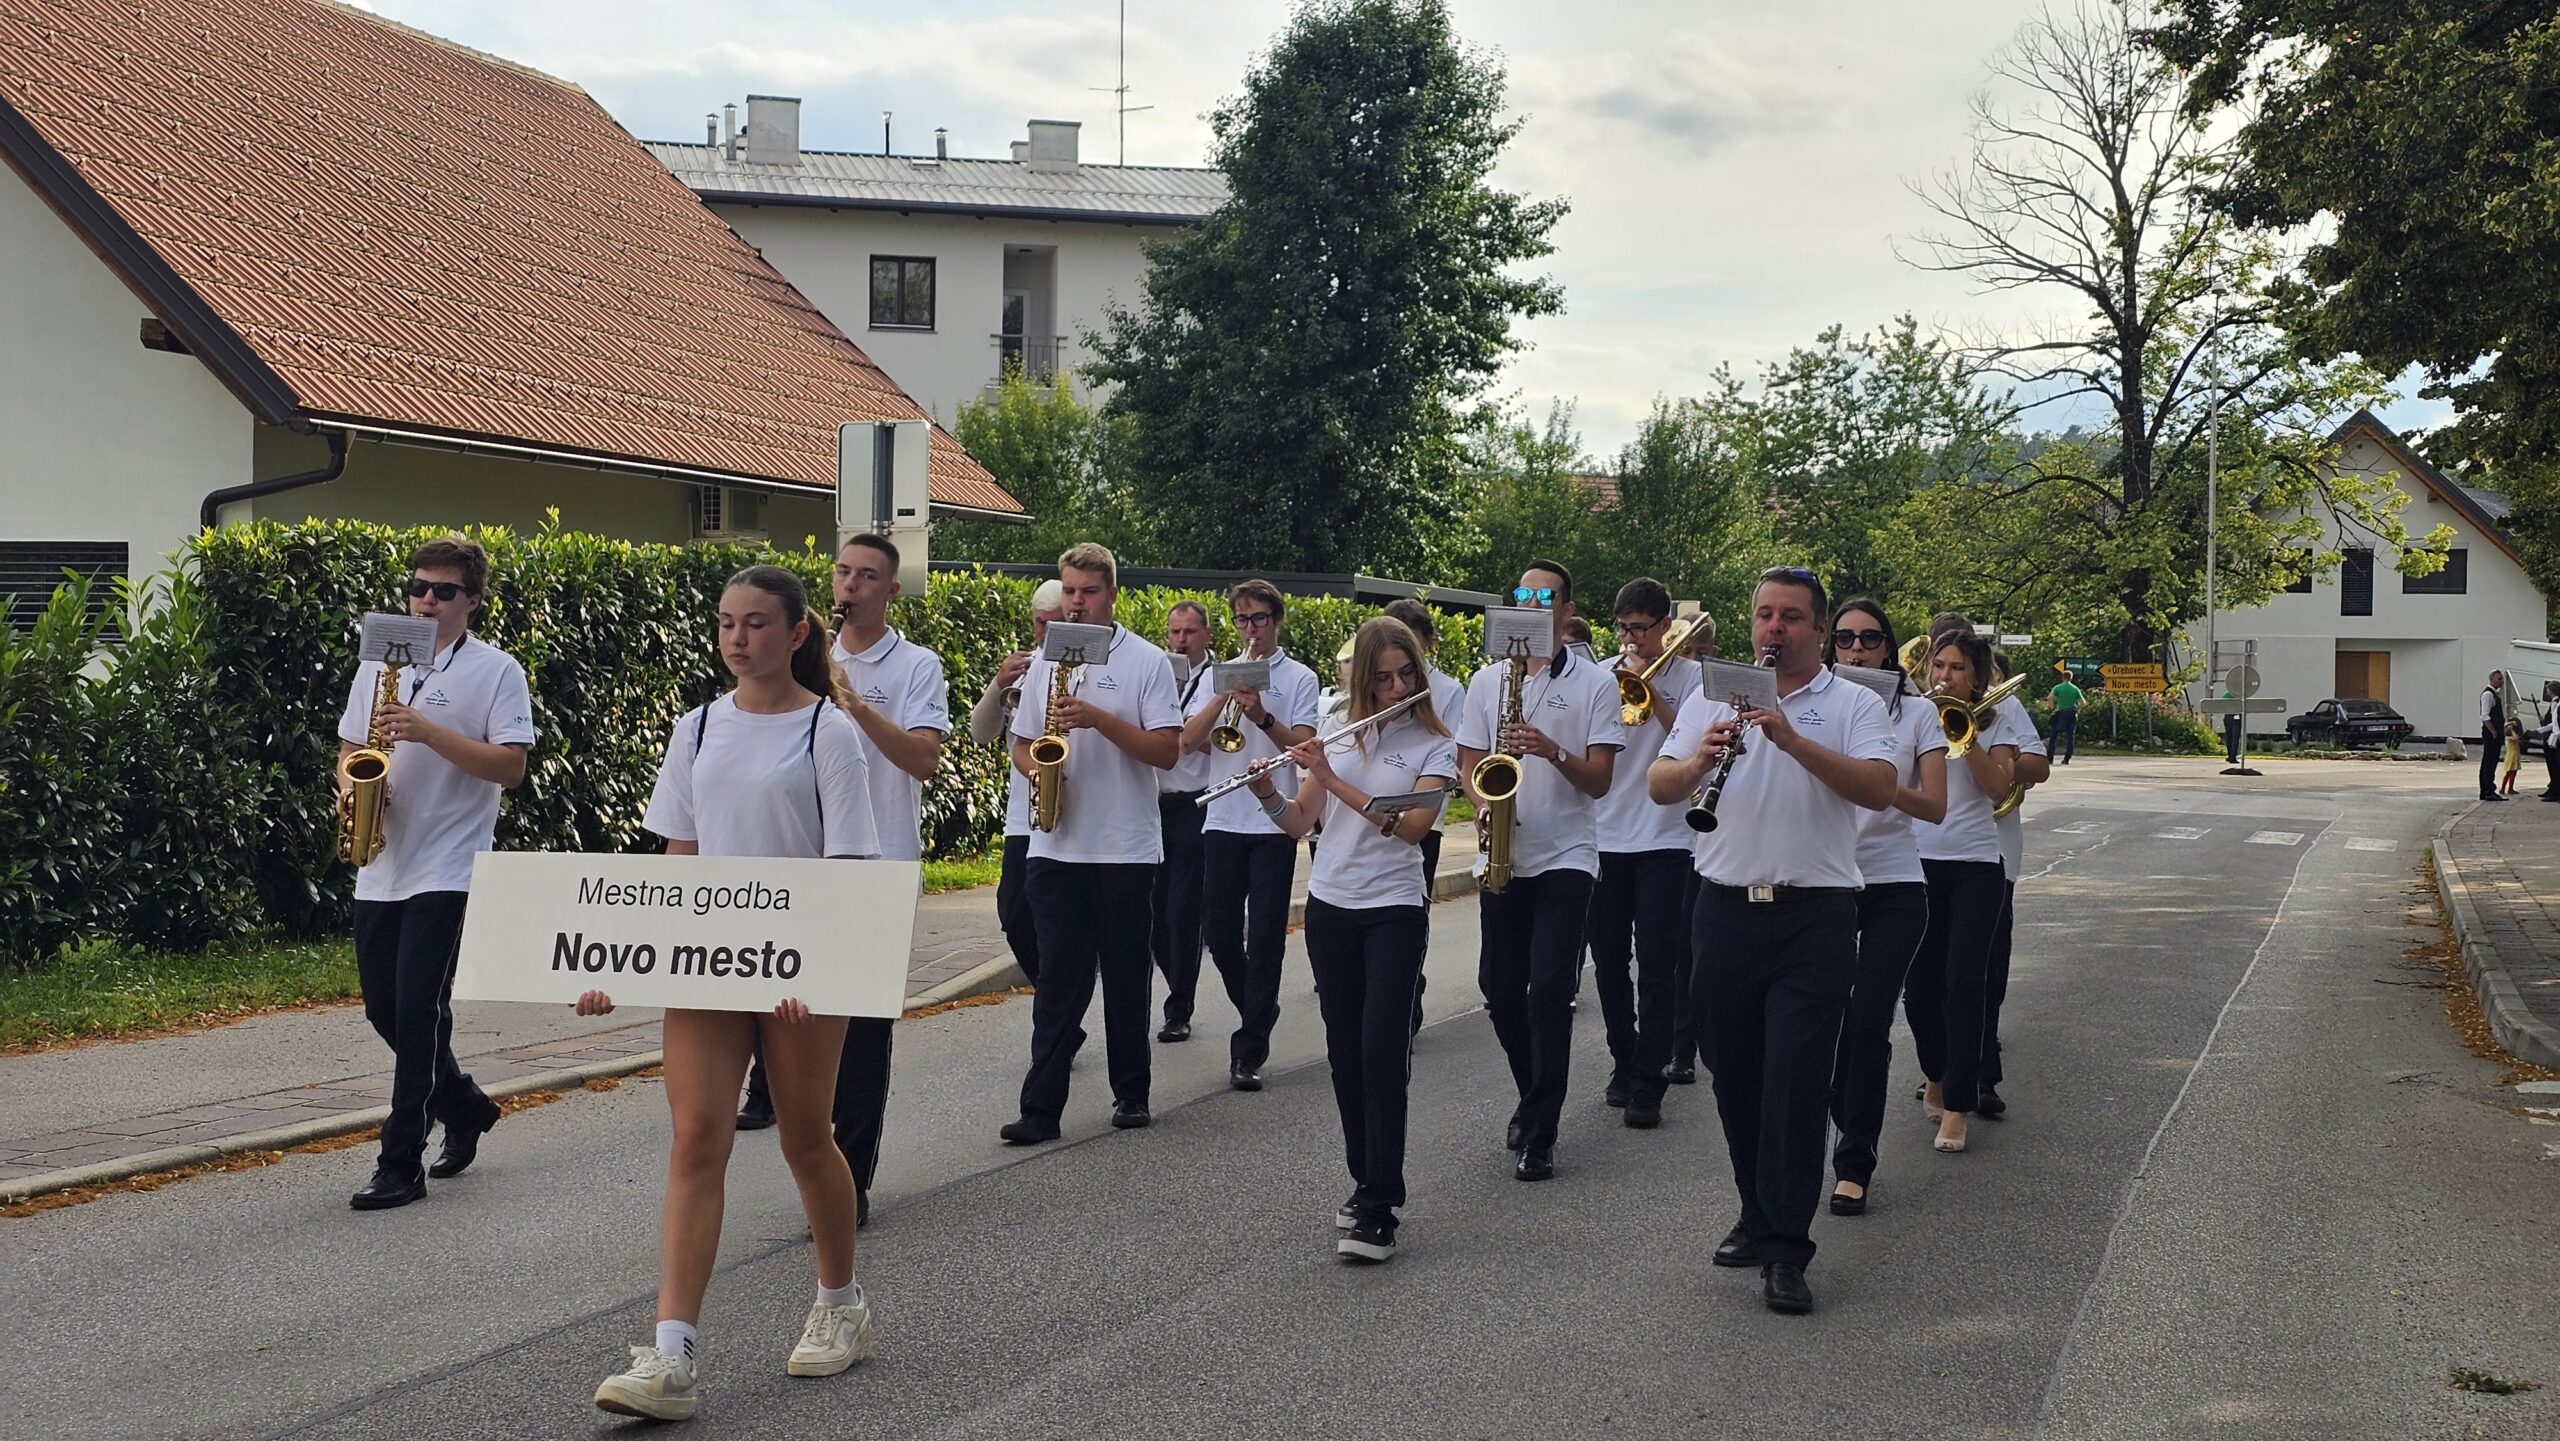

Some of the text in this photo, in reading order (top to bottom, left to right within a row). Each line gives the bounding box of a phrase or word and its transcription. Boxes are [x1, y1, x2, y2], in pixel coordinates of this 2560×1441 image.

[2112, 665, 2155, 674] Orehovec 2
[2111, 680, 2157, 689] Novo mesto
[578, 877, 791, 916] Mestna godba
[551, 932, 802, 980] Novo mesto
